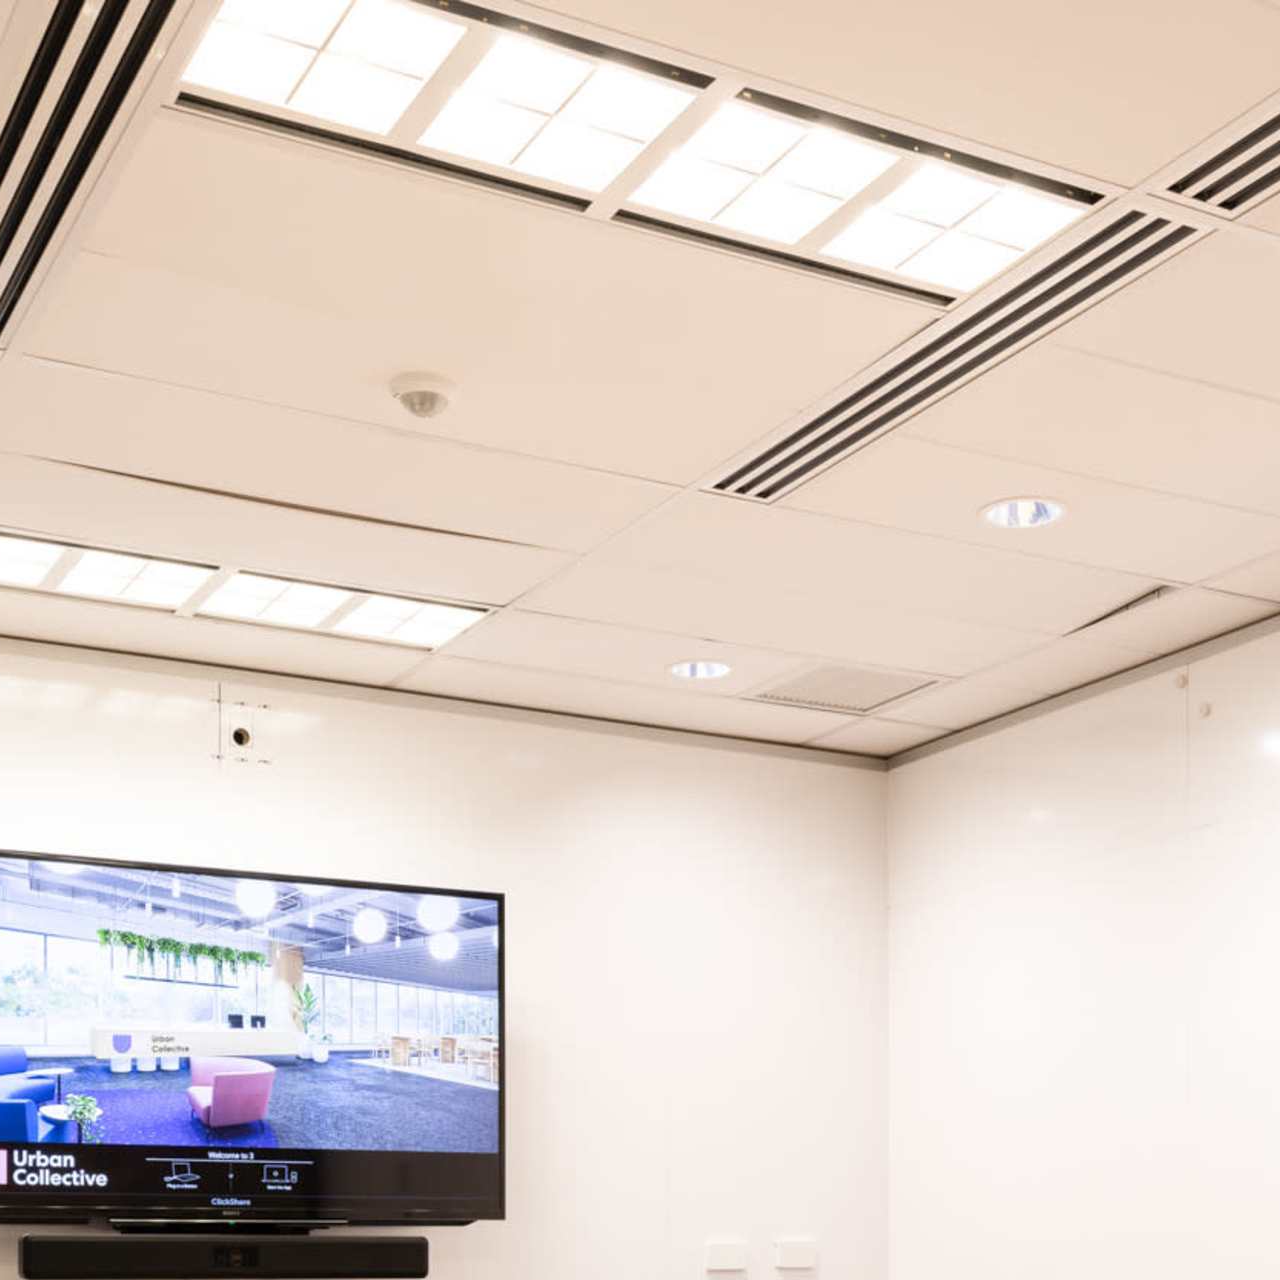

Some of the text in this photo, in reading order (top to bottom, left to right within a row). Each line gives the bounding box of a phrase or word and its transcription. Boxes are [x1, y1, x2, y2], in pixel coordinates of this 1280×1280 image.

[12, 1149, 75, 1167] Urban
[207, 1151, 239, 1160] Welcome
[12, 1168, 108, 1187] Collective
[210, 1198, 251, 1206] ClickShare
